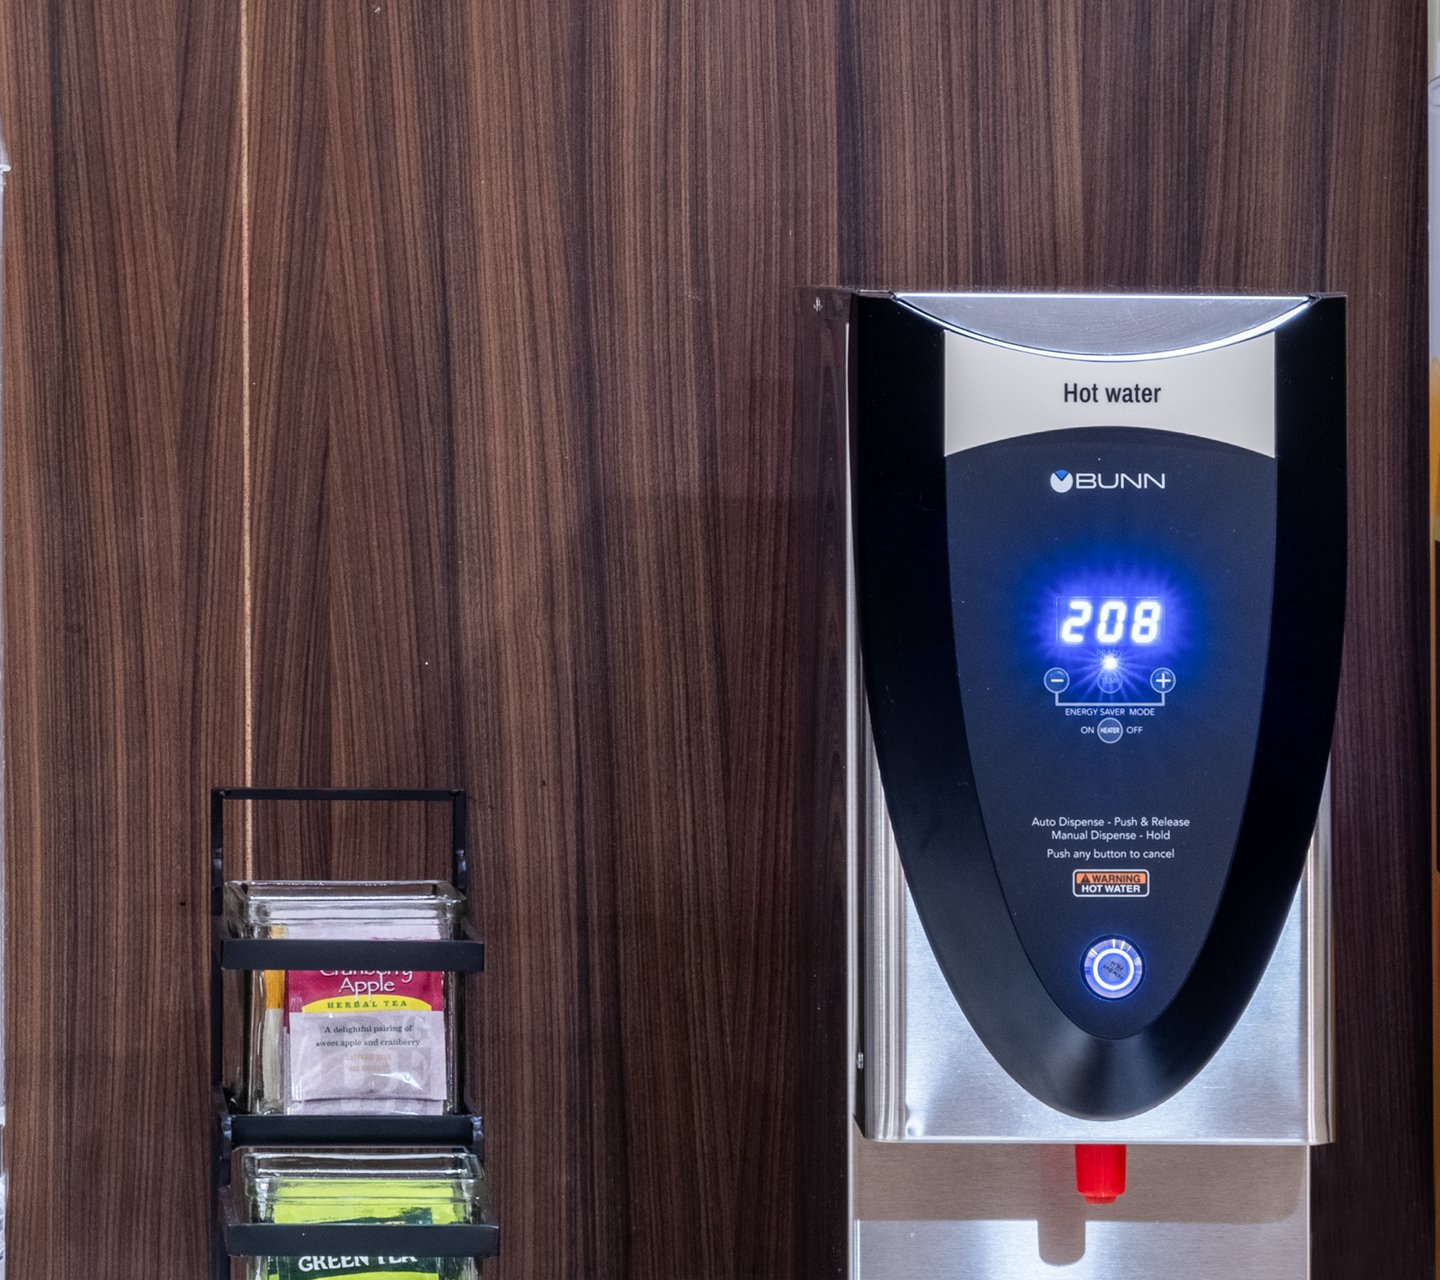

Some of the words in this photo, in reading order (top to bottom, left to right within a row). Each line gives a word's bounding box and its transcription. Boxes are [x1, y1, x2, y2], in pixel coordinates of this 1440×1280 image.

[1064, 382, 1098, 403] Hot
[1105, 383, 1161, 403] water
[1075, 473, 1165, 489] BUNN
[1061, 600, 1161, 643] 208
[1065, 707, 1098, 716] ENERGY
[1099, 707, 1125, 716] SAVER
[1129, 707, 1155, 716] MODE
[1080, 725, 1094, 734] ON
[1100, 726, 1120, 734] HEATER
[1126, 725, 1143, 734] OFF
[1031, 817, 1056, 827] Auto
[1058, 816, 1104, 830] Dispense
[1114, 816, 1137, 827] Push
[1140, 816, 1148, 827] &
[1151, 816, 1190, 827] Release
[1051, 830, 1088, 840] Manual
[1090, 829, 1136, 842] Dispense
[1146, 829, 1170, 840] Hold
[1047, 848, 1070, 858] Push
[1073, 850, 1091, 861] any
[1093, 848, 1127, 858] button
[1129, 850, 1140, 859] to
[1142, 848, 1174, 859] cancel
[1091, 874, 1141, 883] WARNING
[1081, 884, 1103, 893] HOT
[1104, 884, 1140, 893] WATER
[339, 977, 395, 1001] Apple
[327, 1001, 377, 1009] HERBAL
[333, 1025, 372, 1035] delightful
[373, 1025, 403, 1034] pairing
[405, 1024, 413, 1032] of
[340, 1039, 362, 1049] apple
[380, 1039, 421, 1048] cranberry
